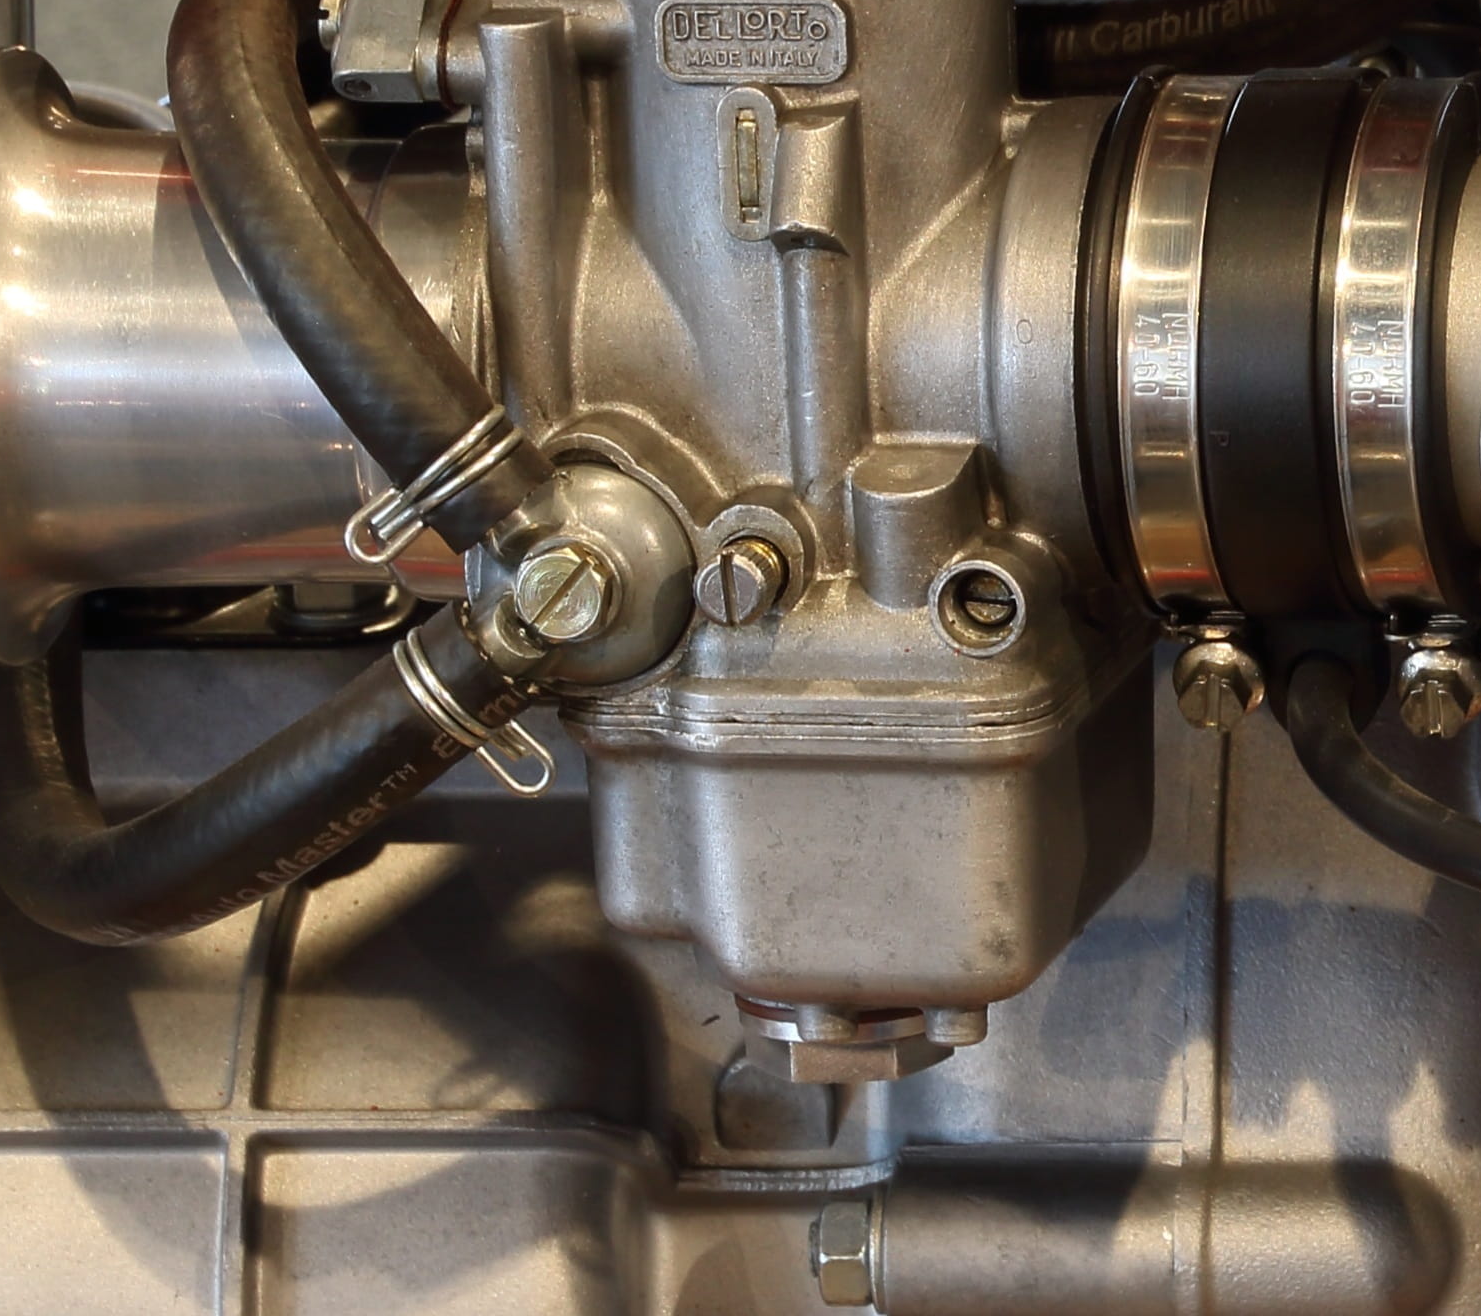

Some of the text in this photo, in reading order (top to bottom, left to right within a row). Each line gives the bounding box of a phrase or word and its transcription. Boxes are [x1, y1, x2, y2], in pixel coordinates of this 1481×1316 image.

[685, 50, 819, 68] MADE IN ITALY
